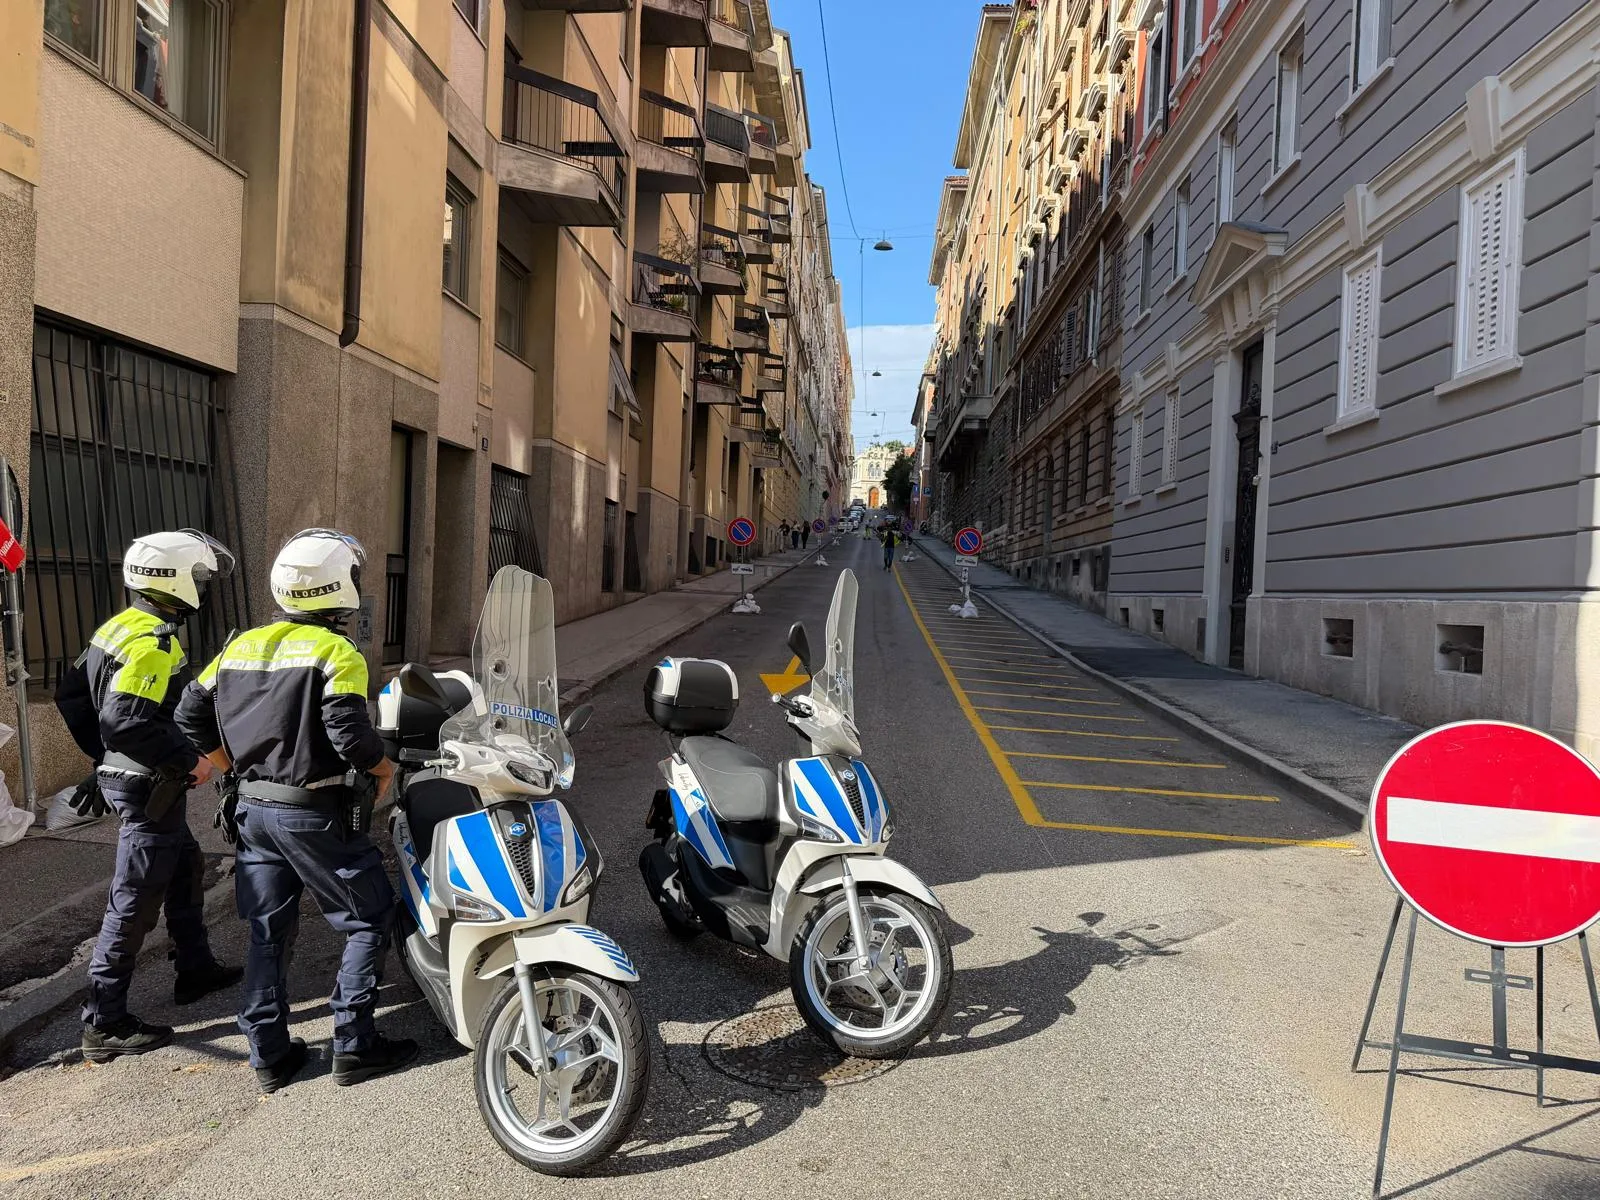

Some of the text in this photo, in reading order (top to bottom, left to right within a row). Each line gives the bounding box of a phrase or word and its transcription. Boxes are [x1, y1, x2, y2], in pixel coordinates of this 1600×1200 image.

[131, 565, 175, 577] LOCALE
[294, 581, 341, 598] LOCALE
[493, 702, 558, 728] POLIZIA LOCALE
